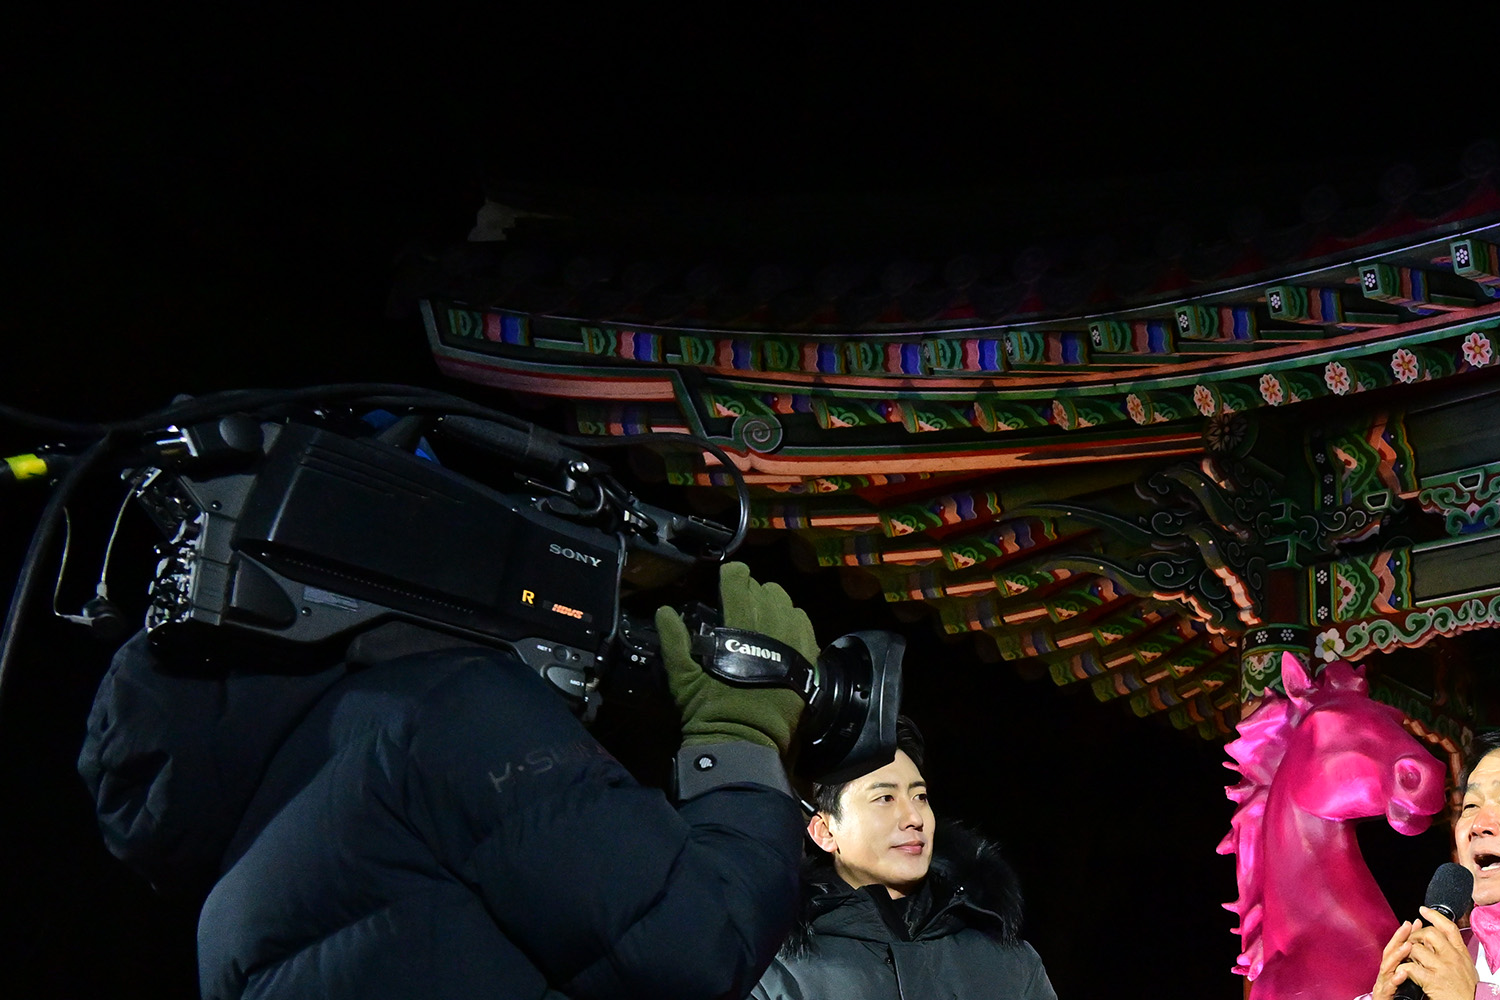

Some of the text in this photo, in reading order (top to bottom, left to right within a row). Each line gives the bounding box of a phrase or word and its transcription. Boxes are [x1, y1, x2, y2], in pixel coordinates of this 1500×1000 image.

[549, 543, 602, 567] SONY
[521, 589, 535, 605] R
[724, 638, 782, 663] Canon
